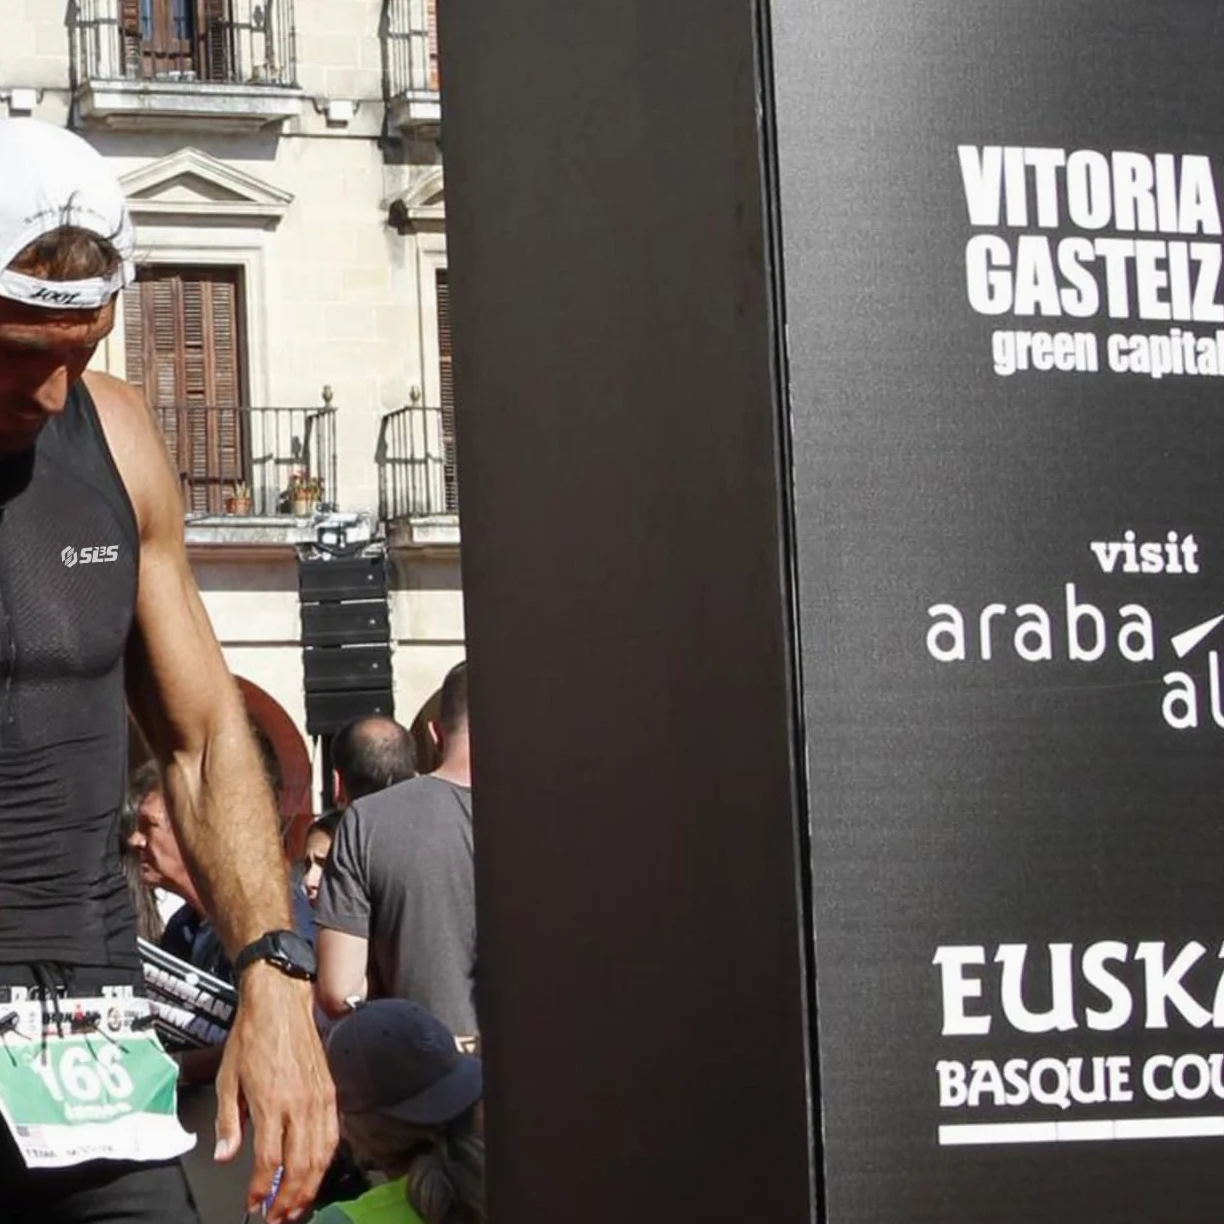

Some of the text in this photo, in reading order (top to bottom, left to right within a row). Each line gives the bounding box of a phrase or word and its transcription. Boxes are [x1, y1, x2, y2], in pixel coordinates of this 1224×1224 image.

[957, 144, 1223, 235] VITORIA
[965, 234, 1224, 322] GASTEIZ
[992, 330, 1099, 376] green
[1090, 530, 1199, 574] visit
[926, 582, 1155, 662] araba
[932, 940, 1224, 1035] EUSK
[29, 1043, 135, 1102] 166
[935, 1056, 1134, 1110] BASQUE
